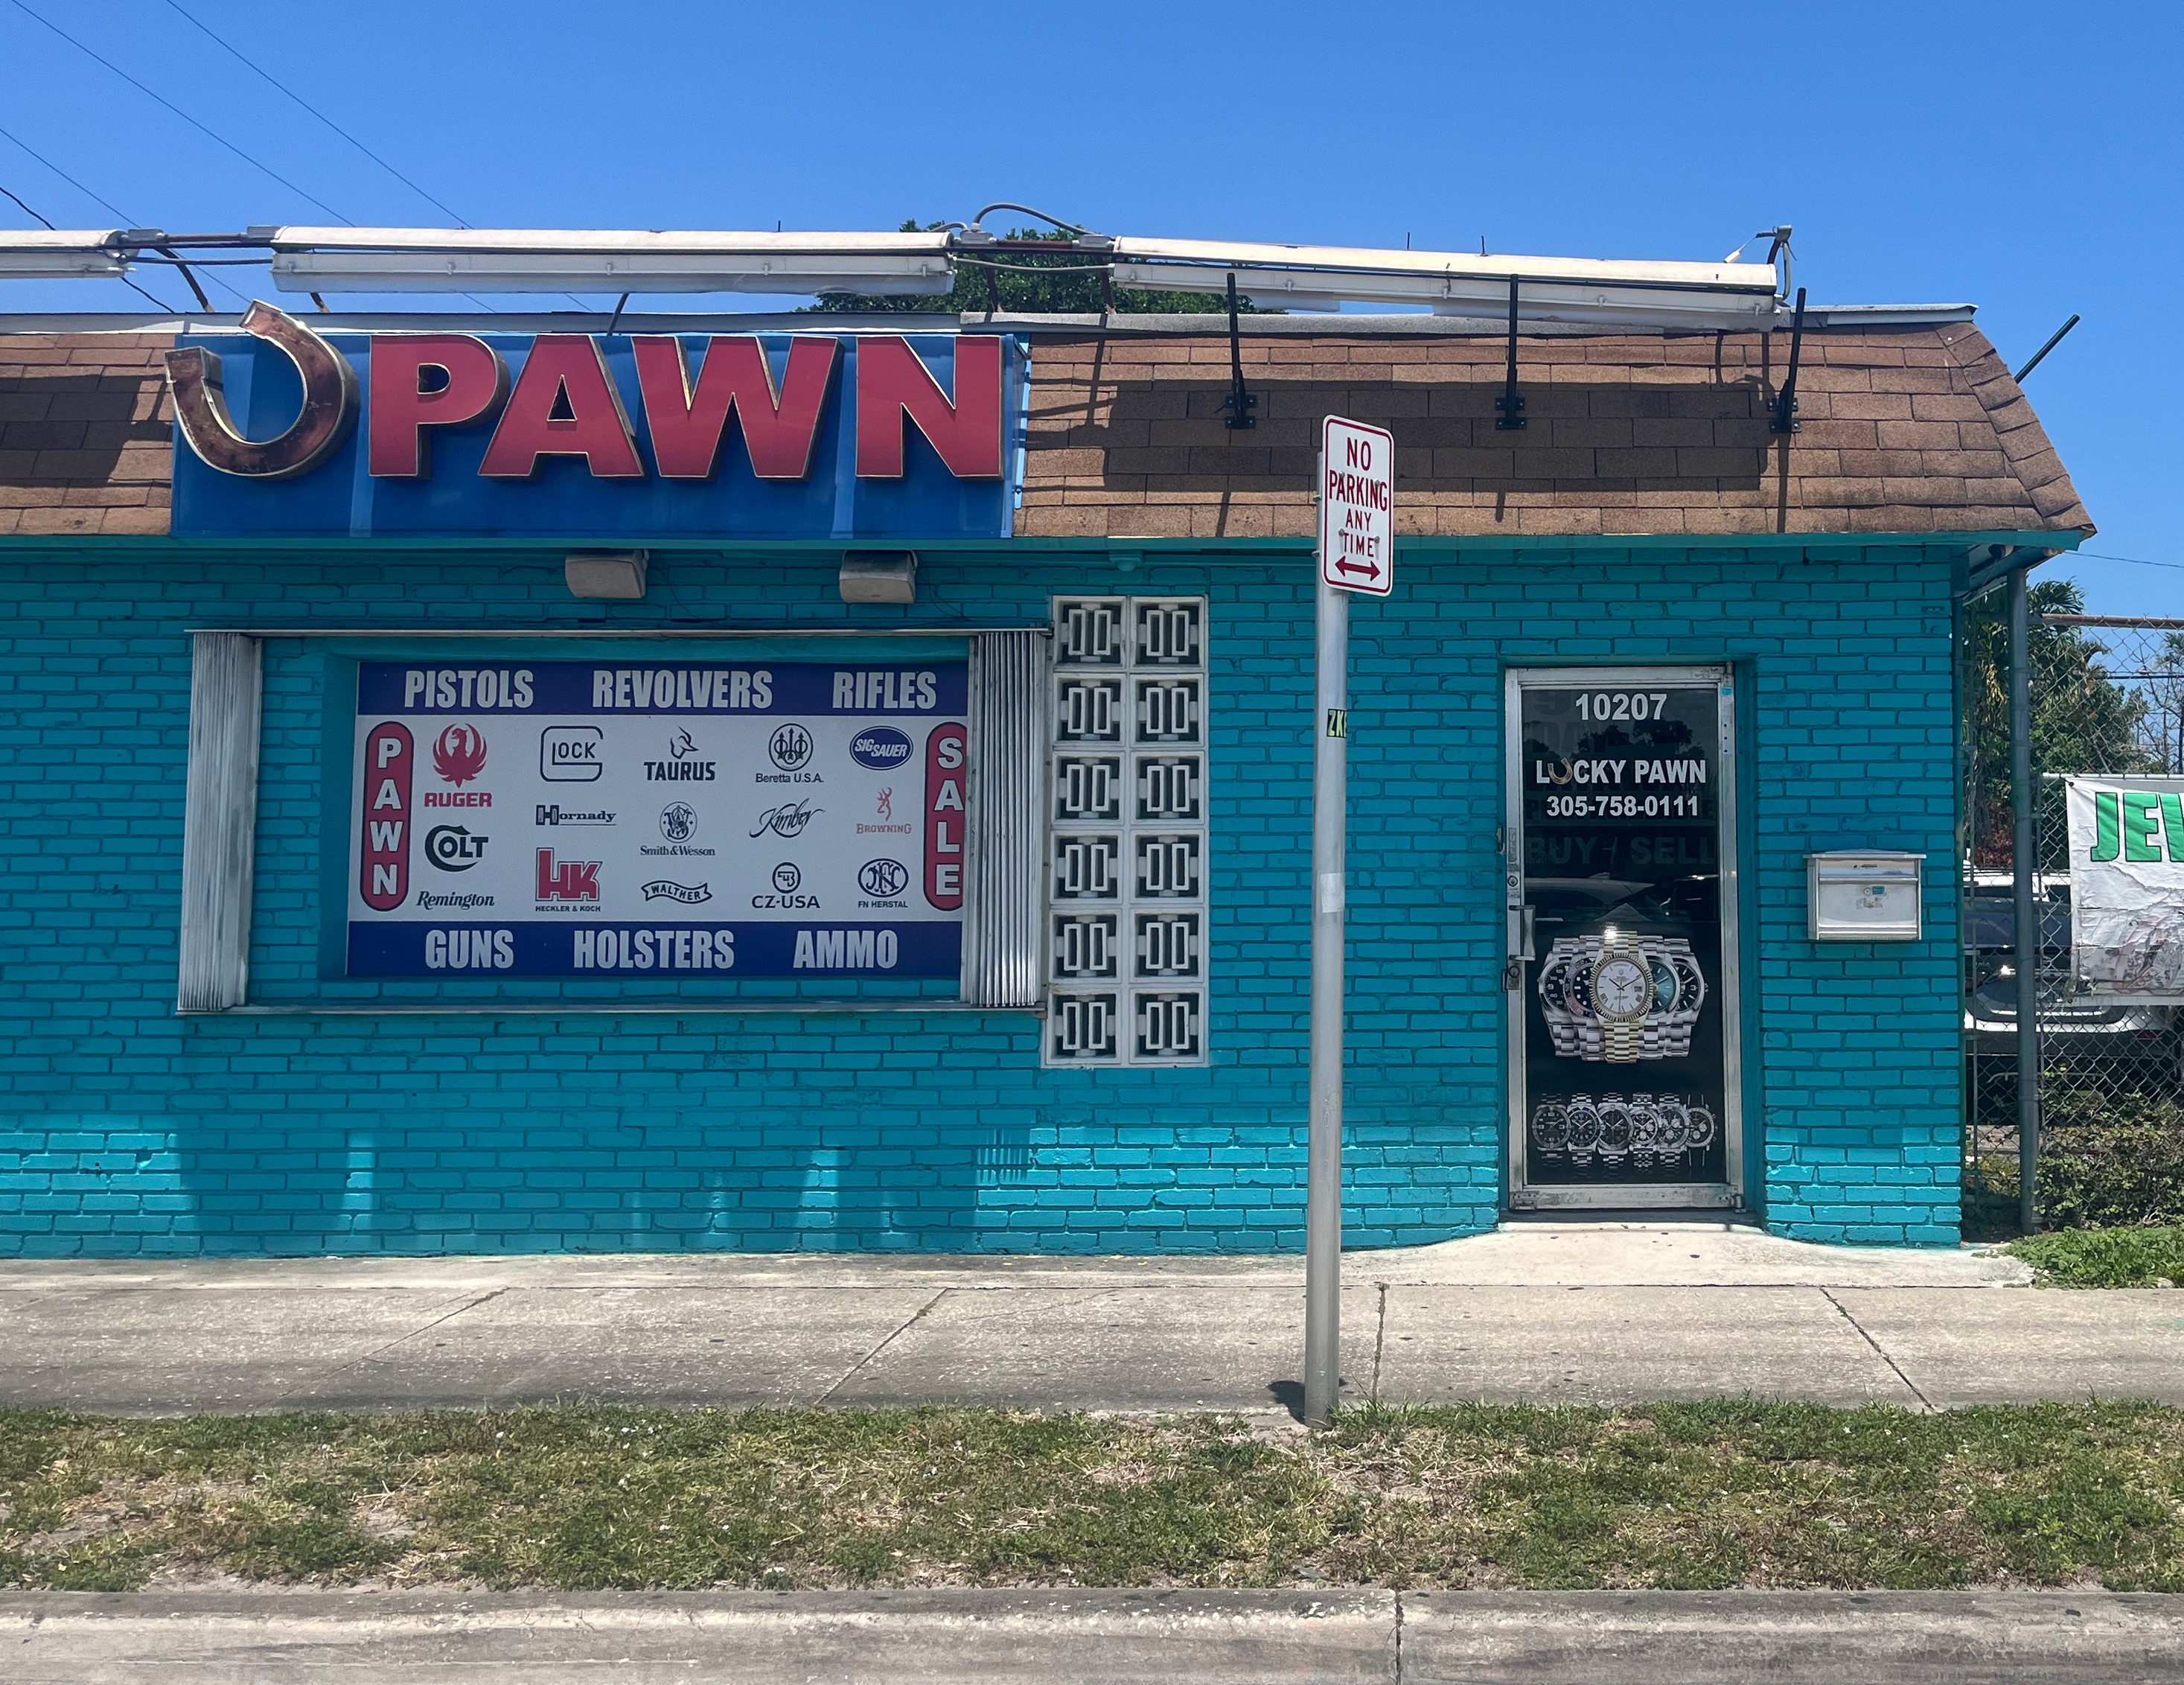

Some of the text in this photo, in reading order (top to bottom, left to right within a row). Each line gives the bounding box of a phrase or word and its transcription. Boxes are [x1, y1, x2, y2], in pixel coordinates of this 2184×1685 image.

[368, 334, 1006, 480] PAWN
[1347, 437, 1372, 471] NO
[1329, 470, 1388, 512] PARKING
[1345, 509, 1372, 532] ANY
[1344, 532, 1375, 558] TIME
[404, 670, 937, 709] PISTOLS REVOLVERS RIFLES
[1576, 694, 1667, 720] 10207
[540, 725, 604, 782] GLOCK
[855, 739, 908, 757] SIG SAUER
[643, 762, 716, 781] TAURUS
[756, 773, 791, 783] Beretta
[1635, 759, 1706, 783] PAWN
[424, 792, 492, 807] RUGER
[1547, 795, 1698, 816] 305-758-0111
[370, 737, 405, 896] PAWN
[536, 805, 616, 825] Hornady
[749, 797, 826, 838] Kimber
[934, 737, 965, 896] SALE
[856, 823, 913, 834] BROWNING
[424, 825, 488, 873] COLT
[415, 891, 495, 910] Remington
[651, 884, 701, 900] WALTHER
[752, 895, 820, 908] CZ-USA
[425, 930, 898, 969] GUNS HOLSTERS AMMO
